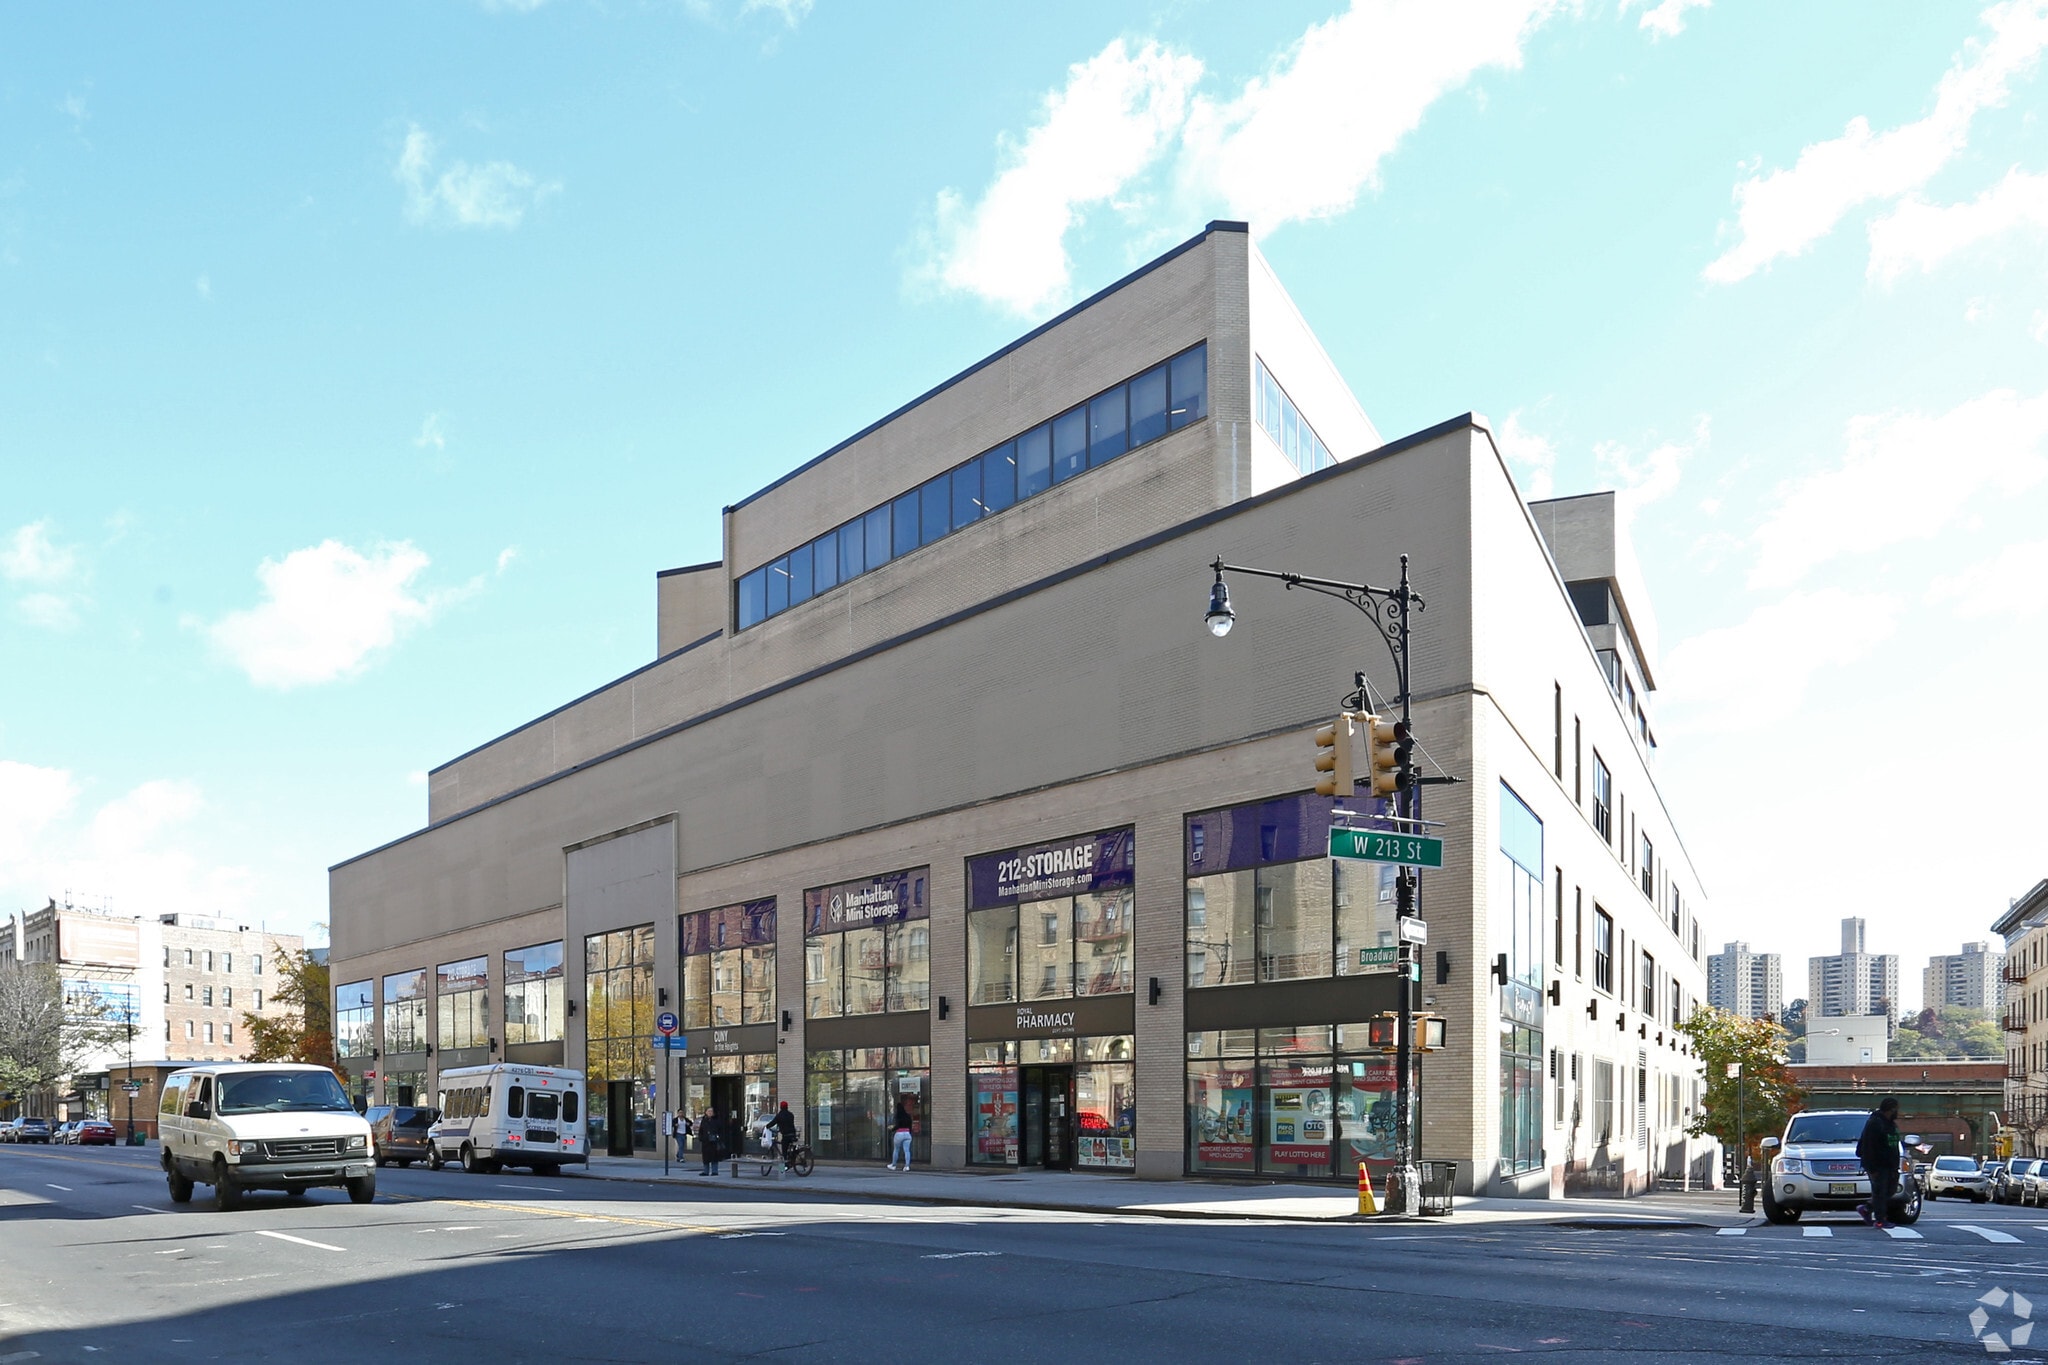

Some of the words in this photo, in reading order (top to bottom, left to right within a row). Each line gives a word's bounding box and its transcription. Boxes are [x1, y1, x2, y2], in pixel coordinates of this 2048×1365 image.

[1354, 835, 1368, 854] W
[1375, 838, 1400, 858] 213
[1407, 841, 1422, 860] St
[998, 844, 1093, 883] 212-STORAGE
[998, 873, 1093, 897] ManhattanMiniStorage.com
[846, 884, 893, 908] Manhattan
[846, 906, 864, 922] Mini
[864, 903, 899, 918] Storage
[1361, 950, 1398, 962] Broadway
[1017, 1012, 1075, 1028] PHARMACY
[713, 1030, 728, 1042] CUNY
[1306, 1121, 1324, 1130] OTC
